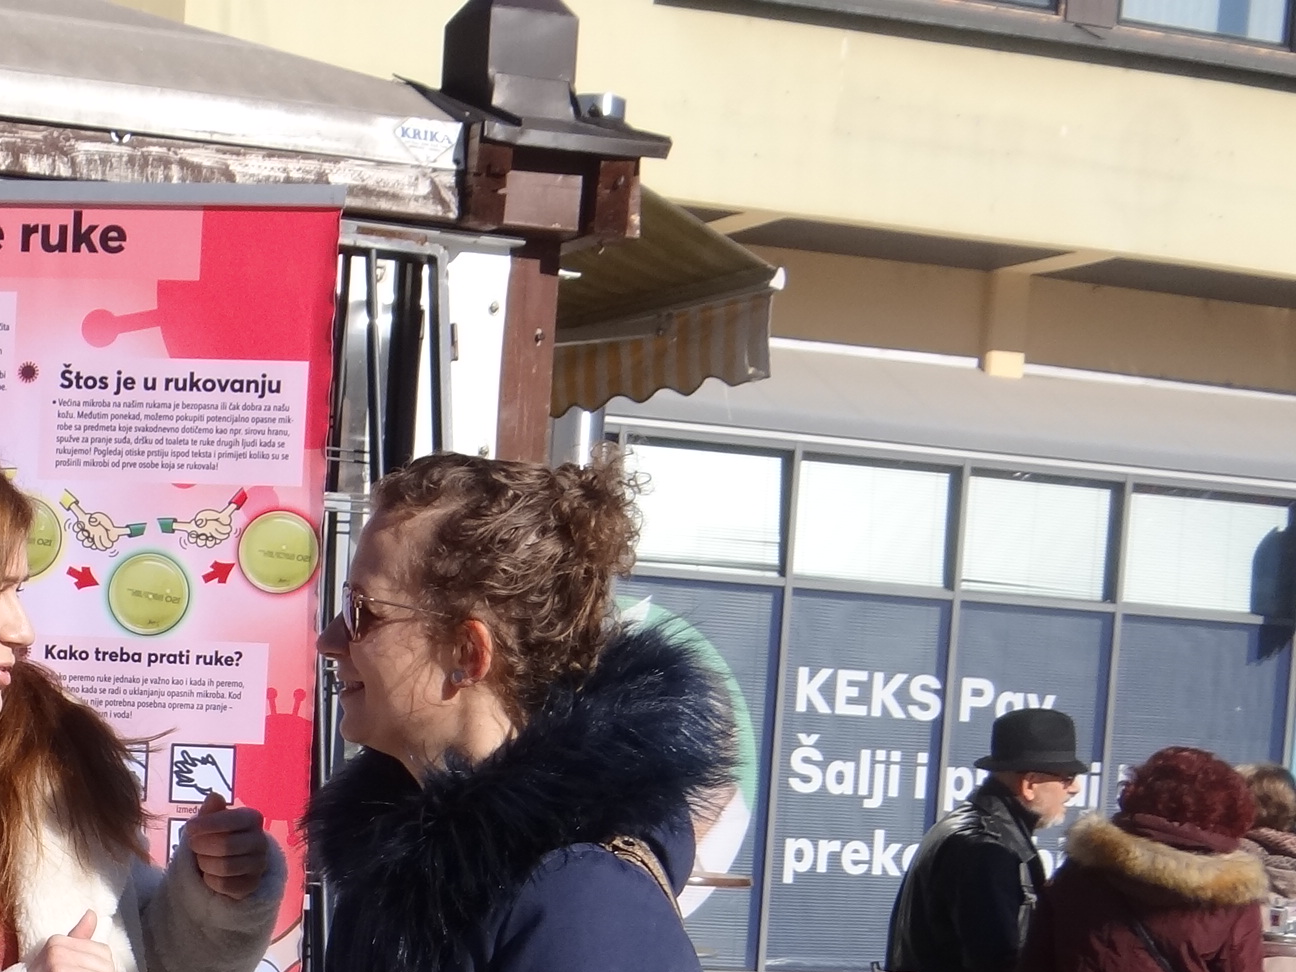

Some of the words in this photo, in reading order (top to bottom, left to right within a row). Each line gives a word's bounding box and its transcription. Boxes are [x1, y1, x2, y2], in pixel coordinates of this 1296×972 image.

[19, 210, 128, 254] ruke
[59, 363, 109, 391] Štos
[114, 370, 136, 396] je
[143, 375, 157, 391] u
[164, 371, 282, 399] rukovanju
[173, 400, 180, 412] je
[229, 402, 240, 411] čak
[273, 403, 290, 412] našu
[278, 414, 294, 424] mik-
[56, 422, 72, 431] robe
[118, 423, 132, 435] koje
[215, 425, 227, 434] kao
[230, 428, 243, 437] npr.
[44, 644, 90, 661] Kako
[94, 646, 142, 664] treba
[147, 648, 190, 668] prati
[195, 649, 243, 667] ruke?
[97, 674, 111, 683] ruke
[142, 676, 148, 687] je
[172, 677, 183, 686] kao
[190, 677, 205, 687] kada
[208, 678, 214, 687] ih
[81, 684, 97, 694] kada
[108, 685, 121, 695] radi
[229, 690, 242, 699] Kod
[796, 666, 942, 721] KEKS
[90, 696, 103, 708] nije
[788, 733, 901, 809] Šalji
[914, 752, 929, 799] i
